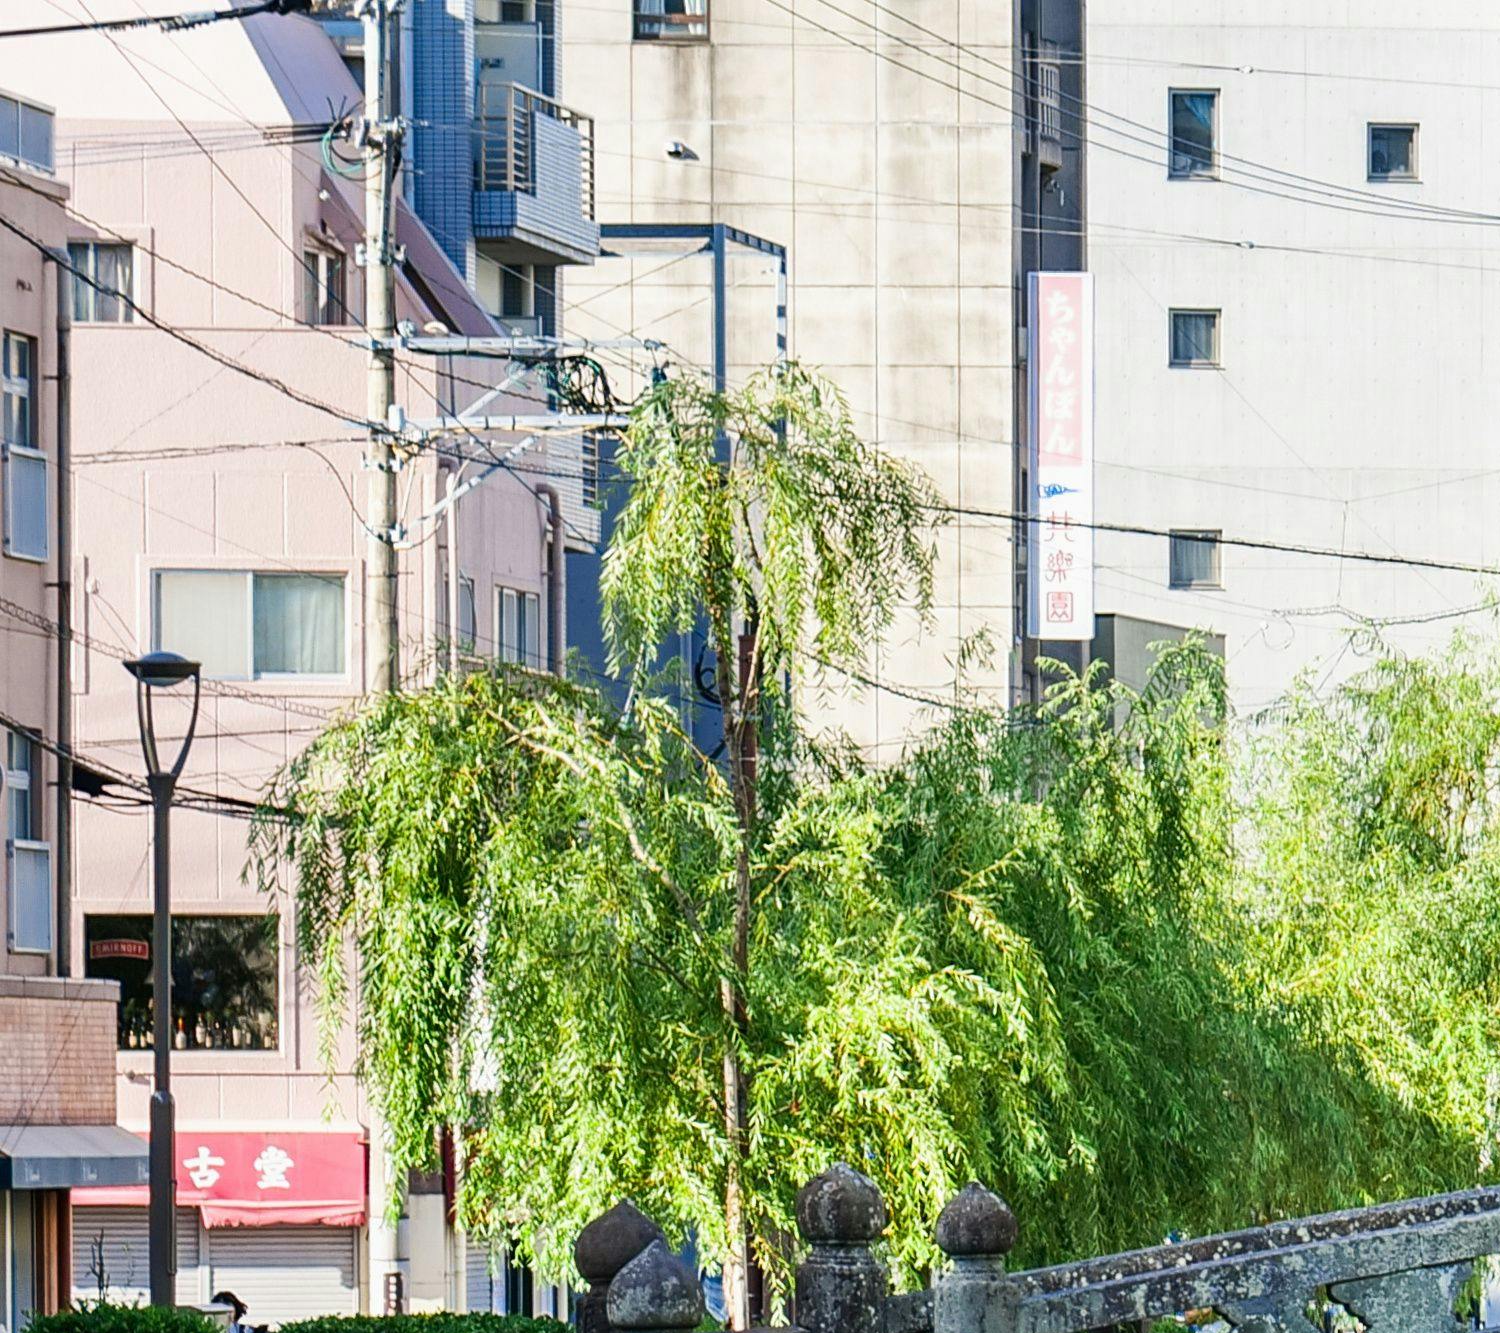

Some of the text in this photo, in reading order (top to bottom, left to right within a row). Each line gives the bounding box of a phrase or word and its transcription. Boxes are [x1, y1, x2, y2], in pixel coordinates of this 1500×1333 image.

[1044, 290, 1078, 454] ちゃんぽん
